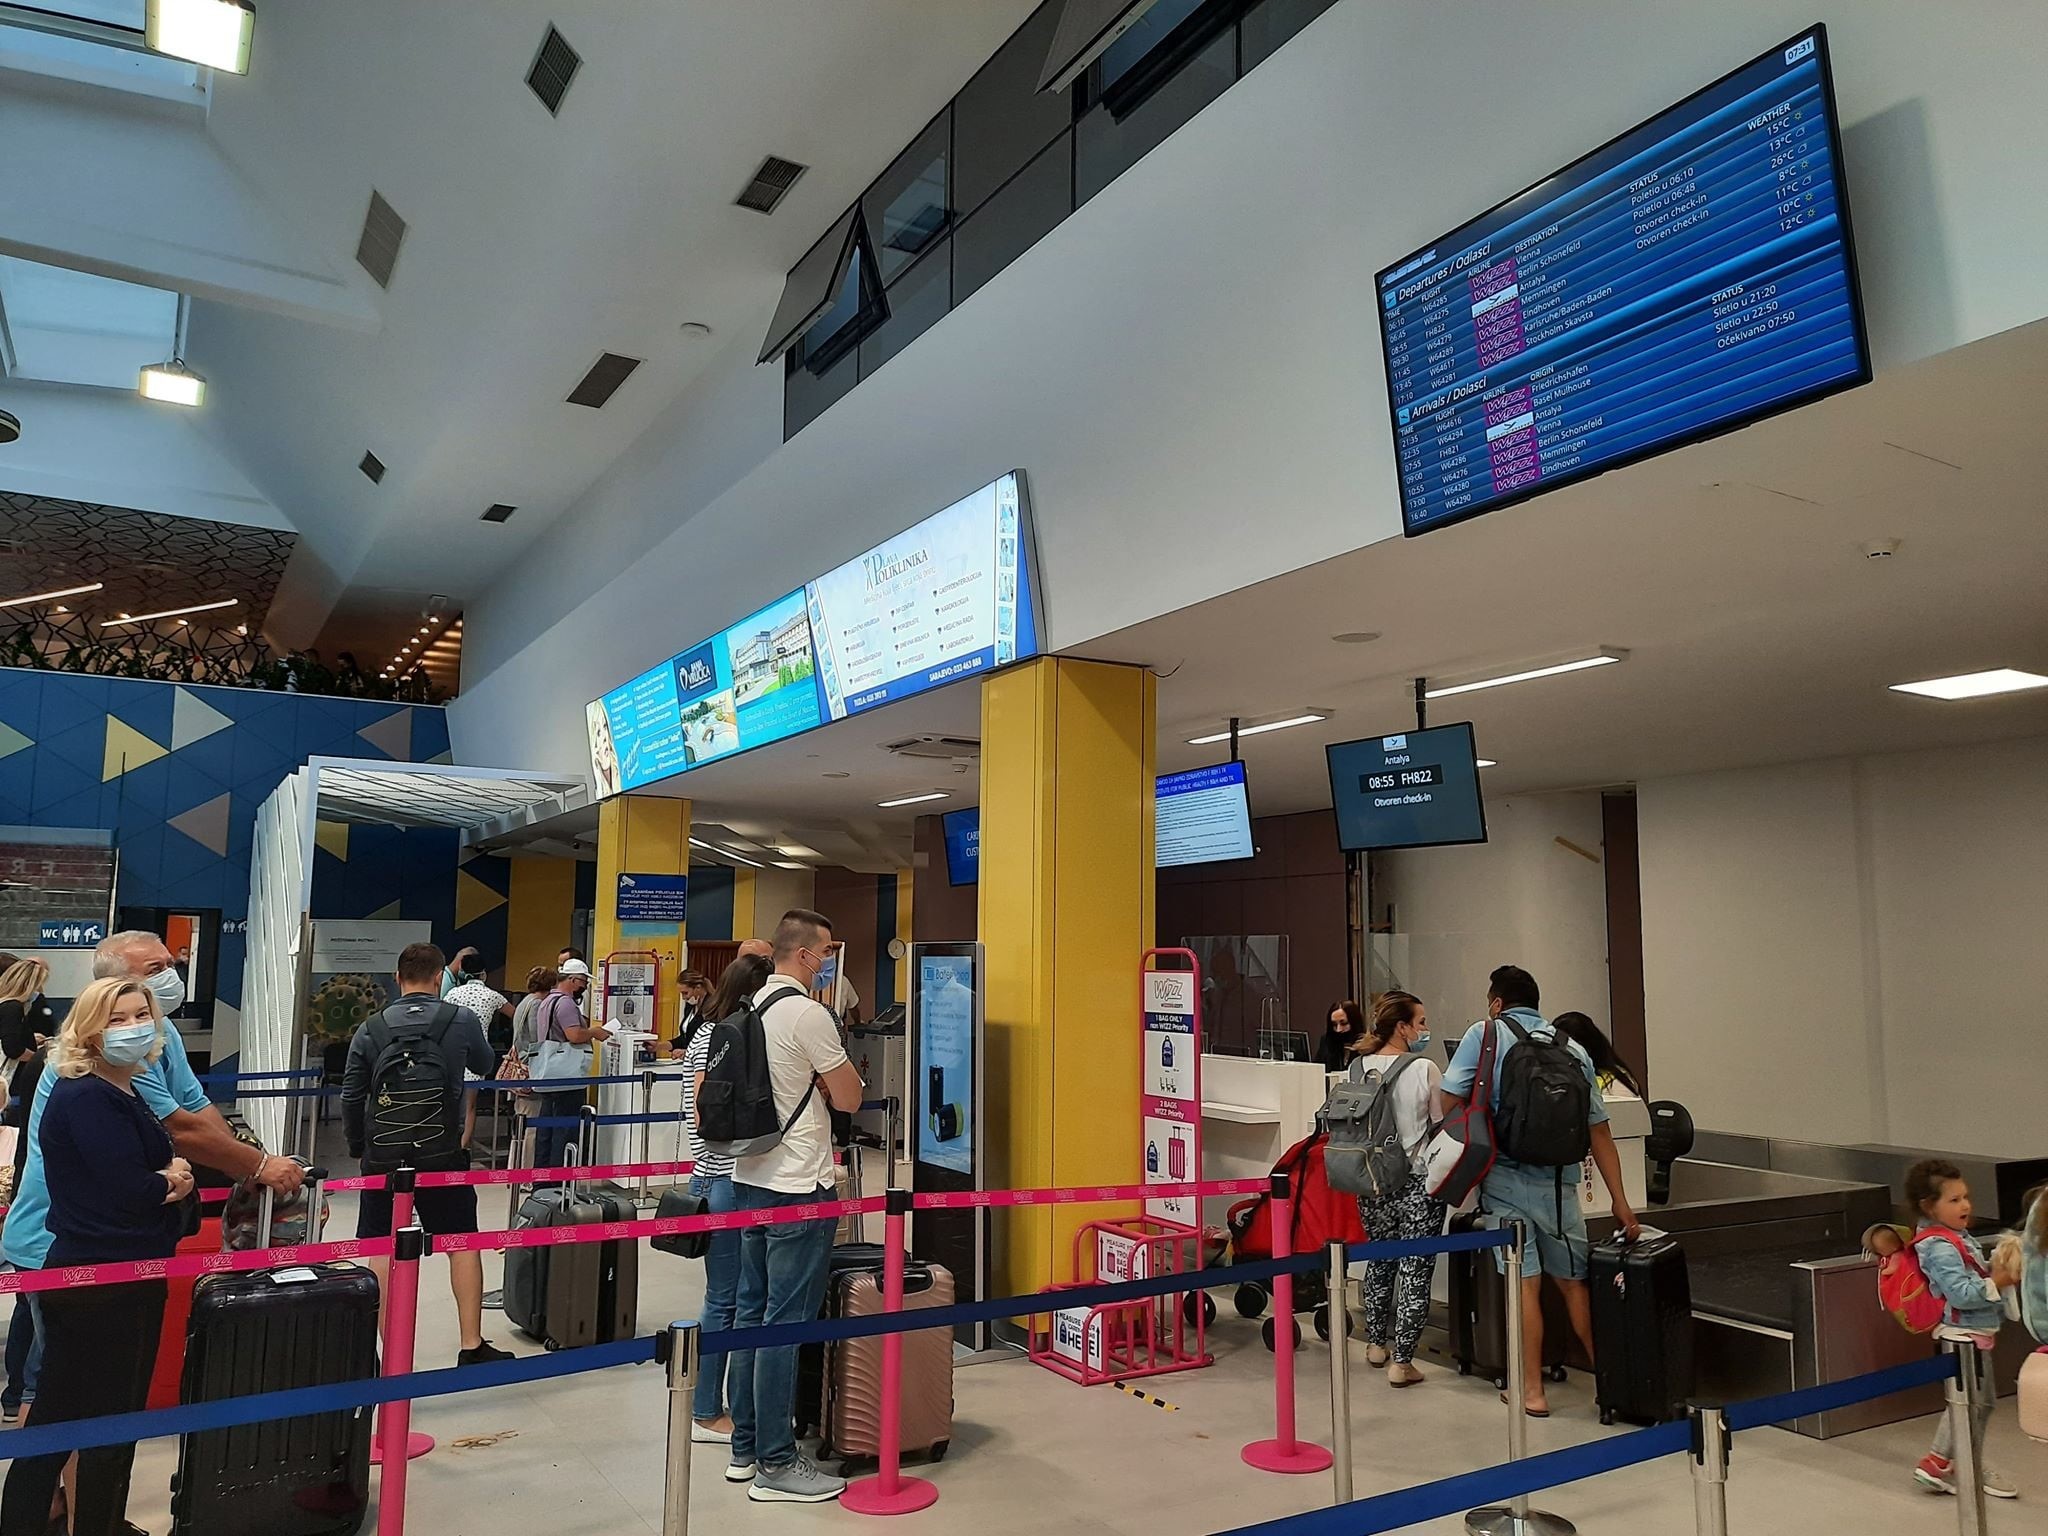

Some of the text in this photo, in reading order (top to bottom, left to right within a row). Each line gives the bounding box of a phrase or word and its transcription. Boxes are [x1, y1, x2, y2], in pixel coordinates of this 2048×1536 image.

[1787, 41, 1812, 60] 07:31
[1748, 103, 1791, 131] WEATHER
[1766, 118, 1790, 136] 15°C
[1769, 135, 1792, 153] 13°C
[1771, 151, 1795, 169] 26°C
[1669, 168, 1694, 186] 06:10
[1779, 166, 1796, 182] 8°C
[1629, 172, 1658, 194] STATUS
[1776, 182, 1799, 200] 11°C
[1664, 197, 1670, 206] u
[1671, 182, 1696, 201] 06:48
[1635, 194, 1707, 236] Otvoren check-in
[1778, 198, 1801, 216] 10°C
[1636, 208, 1709, 250] Otvoren check-in
[1780, 215, 1804, 232] 12°C
[1515, 225, 1558, 253] DESTINATION
[1516, 248, 1540, 265] Vienna
[1518, 240, 1581, 278] Berlin Schonefeld
[1399, 267, 1448, 301] Departures
[1449, 261, 1454, 274] /
[1456, 242, 1490, 270] Odlasci
[1468, 260, 1492, 278] AIRLINE
[1519, 274, 1546, 292] Antalya
[1521, 278, 1567, 305] Memmingen
[1422, 287, 1441, 303] FLIGHT
[1712, 285, 1744, 305] STATUS
[1750, 285, 1776, 303] 21:20
[1387, 308, 1401, 320] TIME
[1522, 296, 1560, 319] Eindhoven
[1524, 286, 1612, 333] Karlsruhe/Baden-Baden
[1752, 300, 1778, 319] 22:50
[1388, 318, 1404, 332] 06:10
[1526, 310, 1594, 347] Stockholm Skavsta
[1717, 311, 1795, 348] Očekivano 07:50
[1390, 331, 1406, 343] 06:45
[1426, 334, 1452, 351] W64279
[1391, 343, 1408, 356] 08:55
[1428, 347, 1454, 364] W64289
[1392, 355, 1409, 368] 09:30
[1430, 359, 1455, 376] W64617
[1394, 367, 1410, 380] 11:45
[1431, 372, 1456, 389] W64281
[1530, 366, 1554, 381] ORIGIN
[1531, 364, 1588, 394] Friedrichshafen
[1395, 379, 1412, 392] 13:45
[1482, 386, 1506, 402] AIRLINE
[1533, 378, 1591, 407] Basel Mulhouse
[1397, 392, 1414, 404] 17:10
[1412, 396, 1445, 419] Arrivals
[1453, 376, 1487, 402] Dolasci
[1435, 408, 1455, 422] FLIGHT
[1535, 404, 1562, 420] Antalya
[1400, 426, 1414, 437] TIME
[1436, 417, 1462, 433] W64616
[1536, 419, 1562, 434] Vienna
[1538, 433, 1559, 448] Berlin
[1560, 417, 1603, 442] Schonefeld
[1402, 435, 1419, 448] 21:35
[1438, 430, 1464, 446] W64294
[1404, 447, 1420, 460] 22:35
[1439, 445, 1459, 458] FH821
[1540, 439, 1587, 462] Memmingen
[1405, 460, 1422, 472] 07:55
[1440, 455, 1467, 471] W64286
[1541, 455, 1580, 476] Eindhoven
[1442, 468, 1468, 484] W64276
[1408, 484, 1424, 496] 10:55
[1409, 497, 1426, 509] 13:00
[1445, 494, 1471, 509] W64290
[1385, 754, 1410, 766] Antalya
[1369, 770, 1432, 789] 08:55 FH822
[1374, 793, 1432, 807] Otvoren check-in
[42, 929, 58, 938] WC
[1172, 1024, 1188, 1032] Priority
[707, 1041, 730, 1072] adidas
[1168, 1110, 1184, 1120] Priority
[1116, 1267, 1139, 1280] HEE
[1068, 1332, 1095, 1356] HEE
